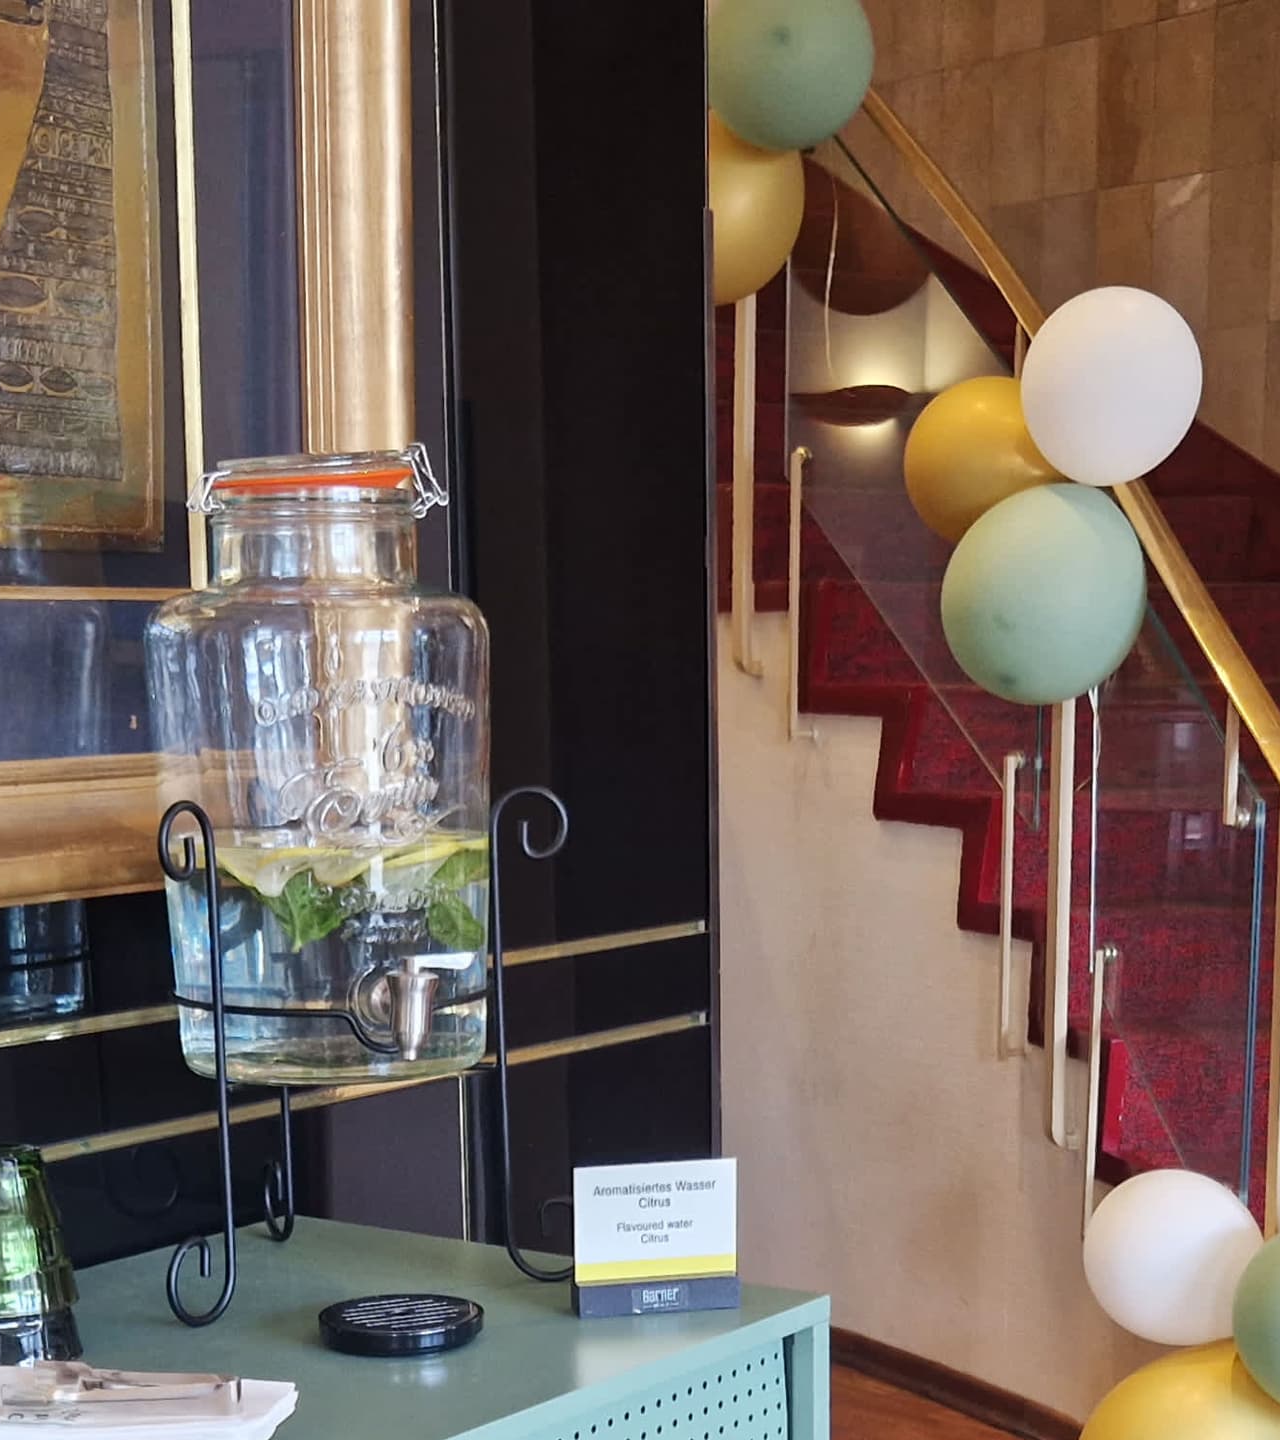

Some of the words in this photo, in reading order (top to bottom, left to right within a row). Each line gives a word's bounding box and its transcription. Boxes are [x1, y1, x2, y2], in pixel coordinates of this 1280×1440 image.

[593, 1183, 672, 1197] Aromatisiertes
[675, 1180, 716, 1192] Wasser
[638, 1197, 671, 1209] Citrus
[616, 1221, 664, 1232] Flavoured
[667, 1219, 693, 1230] water
[640, 1233, 669, 1244] Citrus
